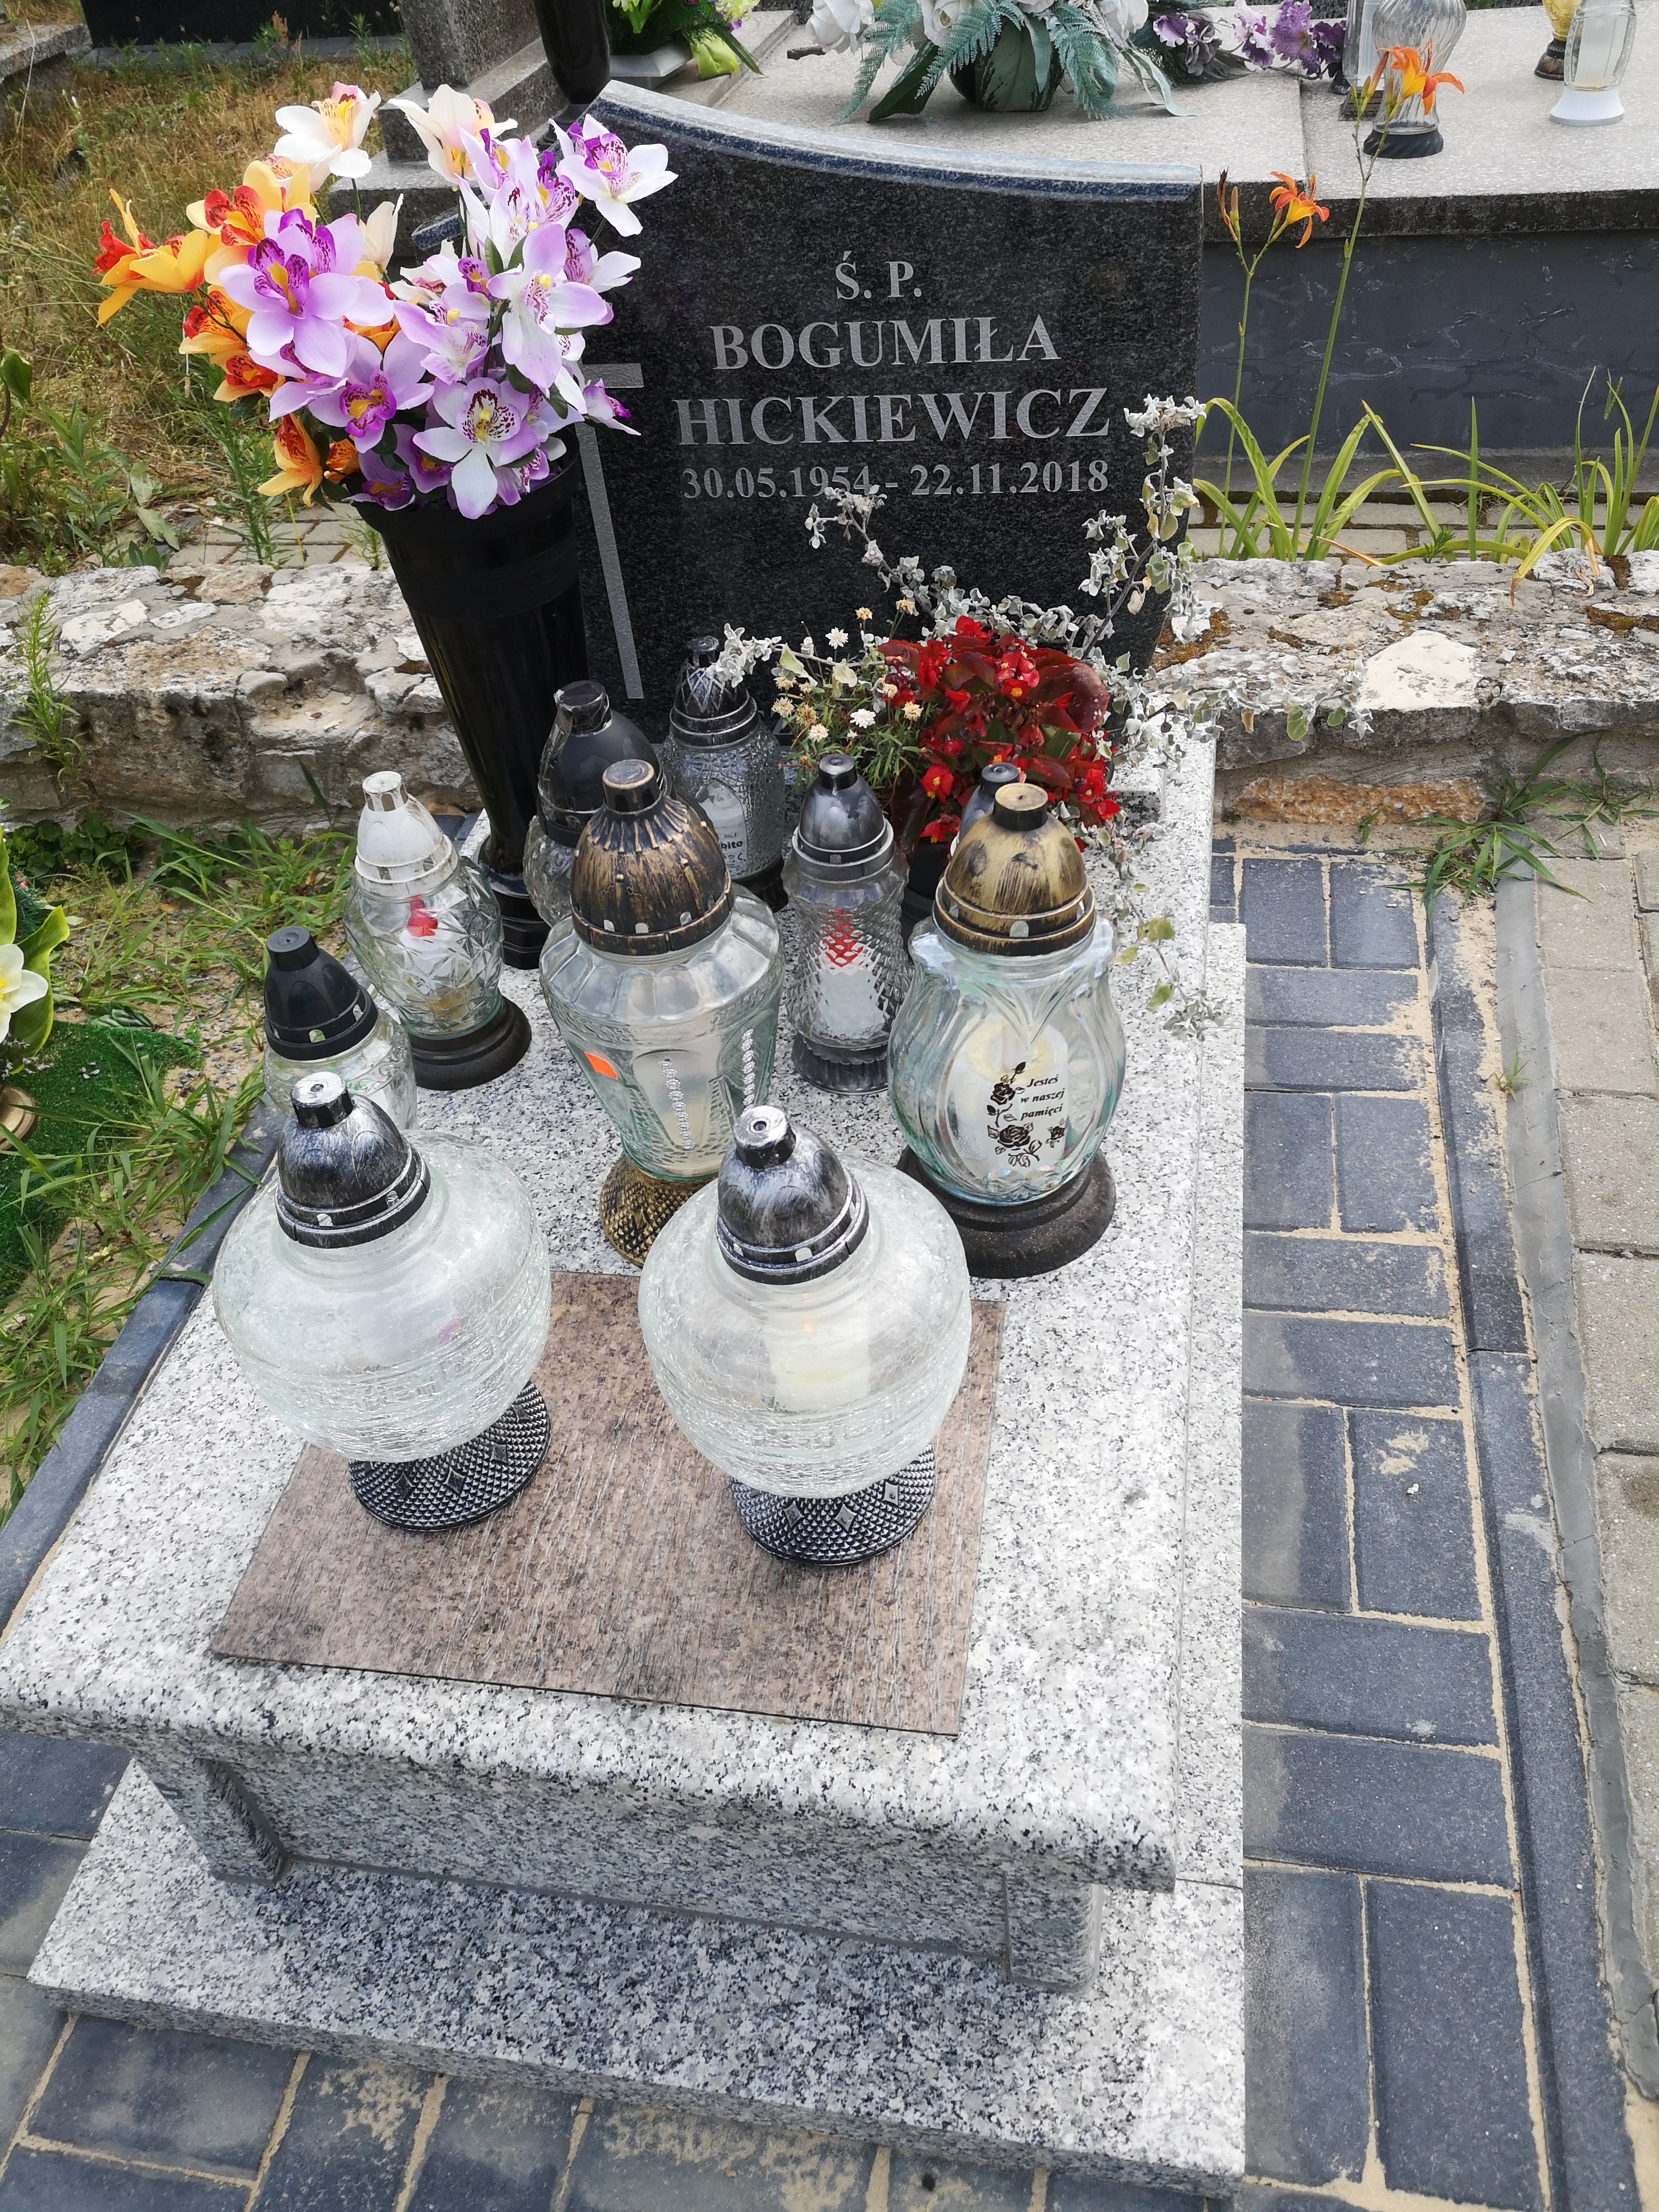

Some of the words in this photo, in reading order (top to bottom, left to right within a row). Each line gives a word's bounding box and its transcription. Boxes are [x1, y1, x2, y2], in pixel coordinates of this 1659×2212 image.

[836, 251, 872, 299] Ś.
[885, 261, 922, 298] P.
[709, 313, 1062, 370] BOGUMIŁA
[672, 387, 1110, 445] HICKIEWICZ
[682, 464, 871, 498] 30.05.1954
[910, 460, 1108, 496] 22.11.2018
[720, 840, 743, 850] bito
[1026, 1074, 1059, 1088] Jesteś
[1032, 1088, 1065, 1103] naszej
[1020, 1103, 1064, 1121] pamięci
